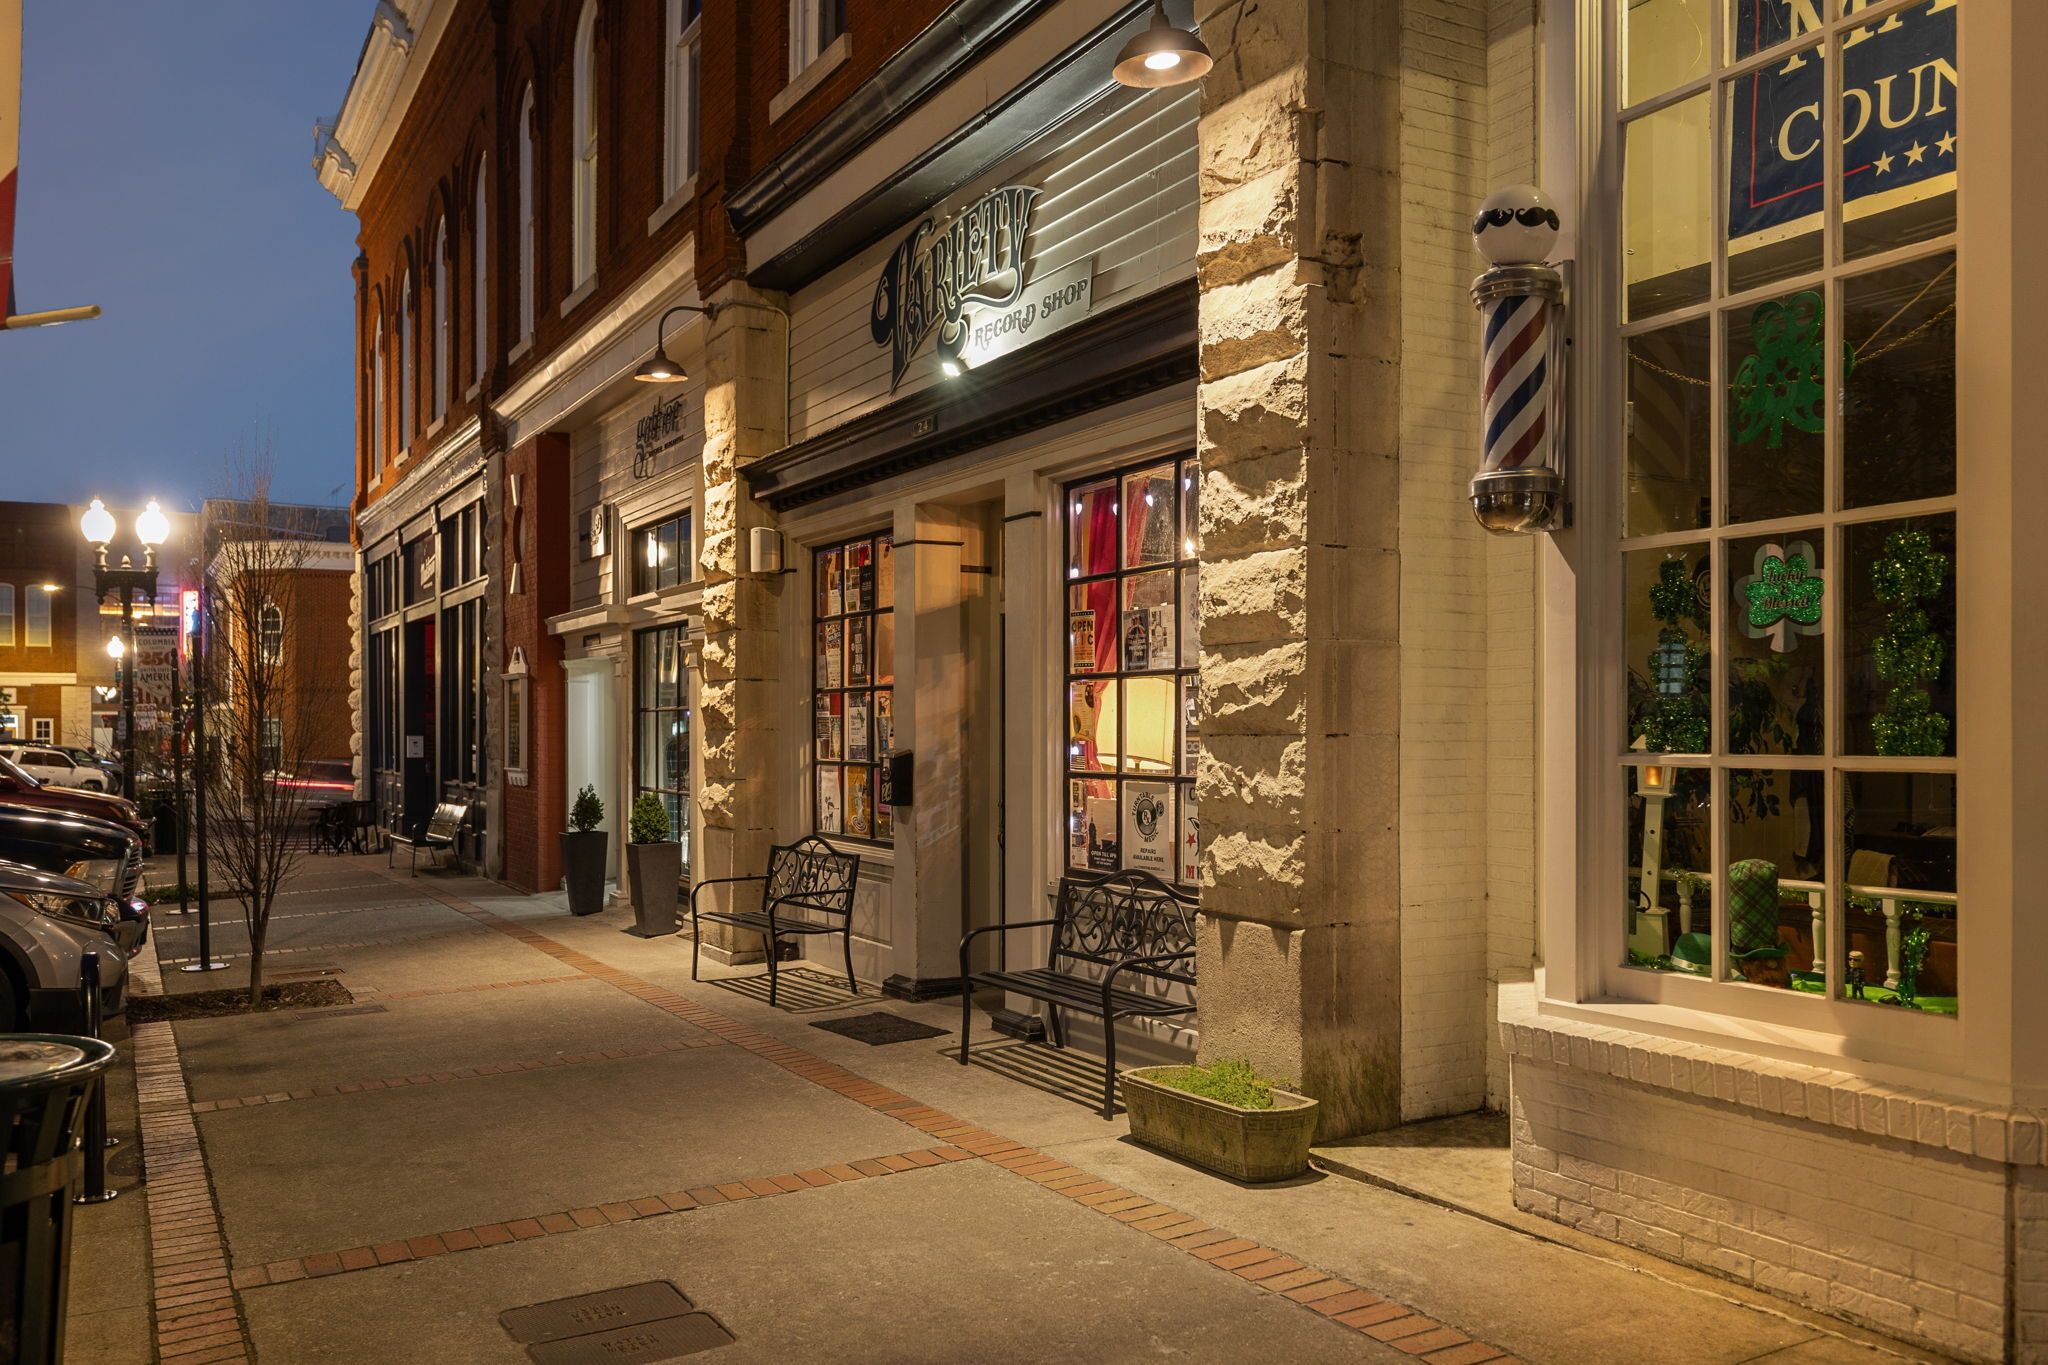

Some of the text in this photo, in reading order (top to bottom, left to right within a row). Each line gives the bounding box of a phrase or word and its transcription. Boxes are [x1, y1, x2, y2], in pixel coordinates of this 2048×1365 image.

[871, 184, 1044, 397] VARIETY
[974, 278, 1088, 351] RECORD SHOP
[1764, 596, 1808, 609] Blessed
[1071, 619, 1093, 633] OPEN
[1131, 791, 1155, 817] TURNTABLE
